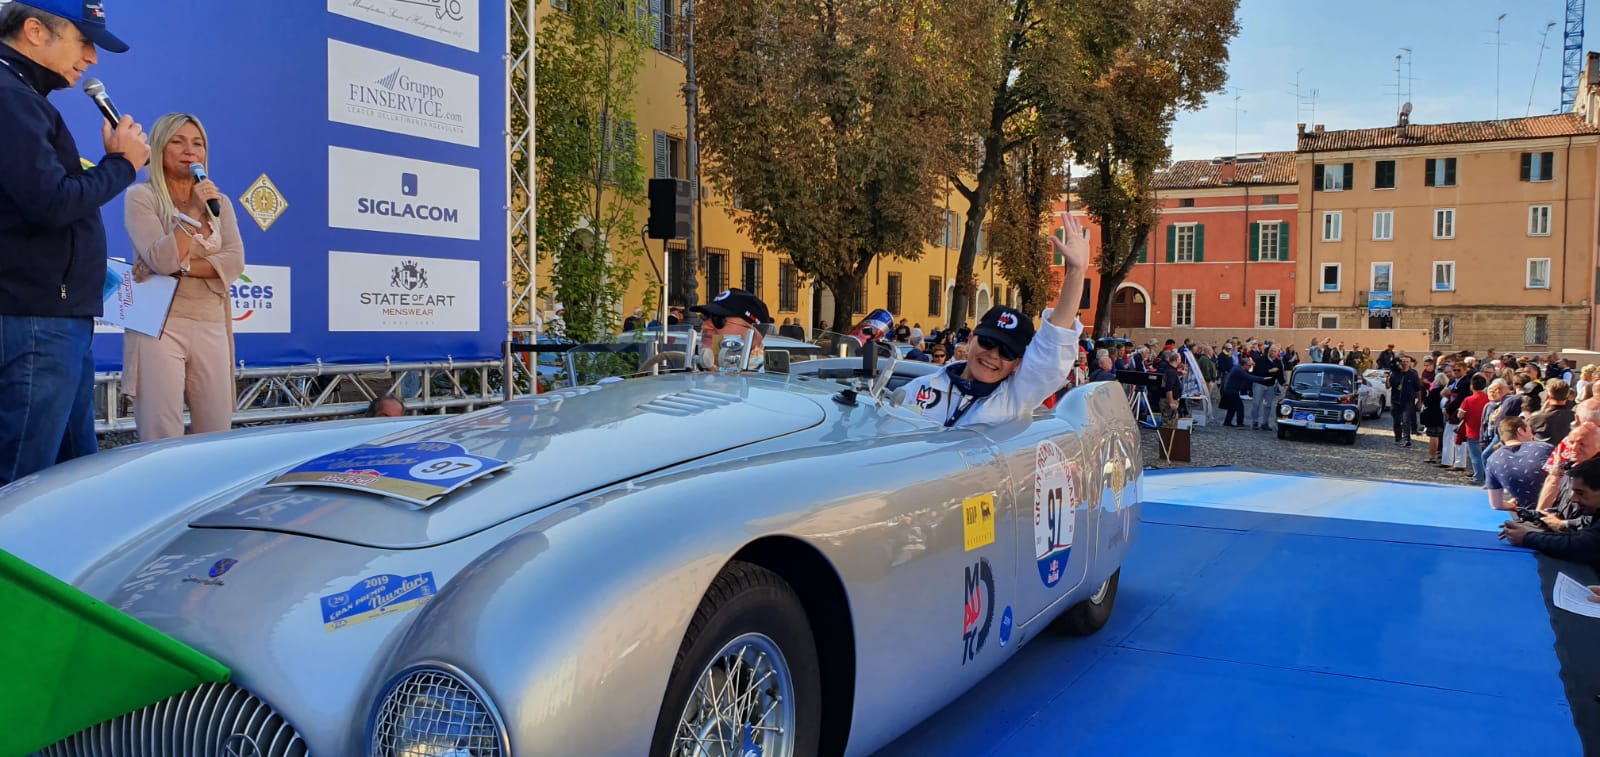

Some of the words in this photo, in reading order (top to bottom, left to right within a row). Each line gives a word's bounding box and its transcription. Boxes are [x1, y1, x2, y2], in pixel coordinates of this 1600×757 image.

[399, 75, 444, 100] Gruppo
[350, 83, 463, 122] FINSERVICE.com
[357, 197, 458, 223] SIGLACOM
[360, 292, 410, 306] STATE
[412, 294, 424, 302] OF
[425, 295, 455, 306] ART
[382, 308, 434, 316] MENSWEAR
[422, 461, 473, 475] 97
[1048, 487, 1062, 552] 97
[365, 575, 389, 589] 2019
[368, 574, 429, 609] Nuvolari
[965, 562, 979, 604] M
[355, 585, 386, 606] PREMIO
[329, 603, 353, 620] GRAN
[963, 585, 982, 635] AU
